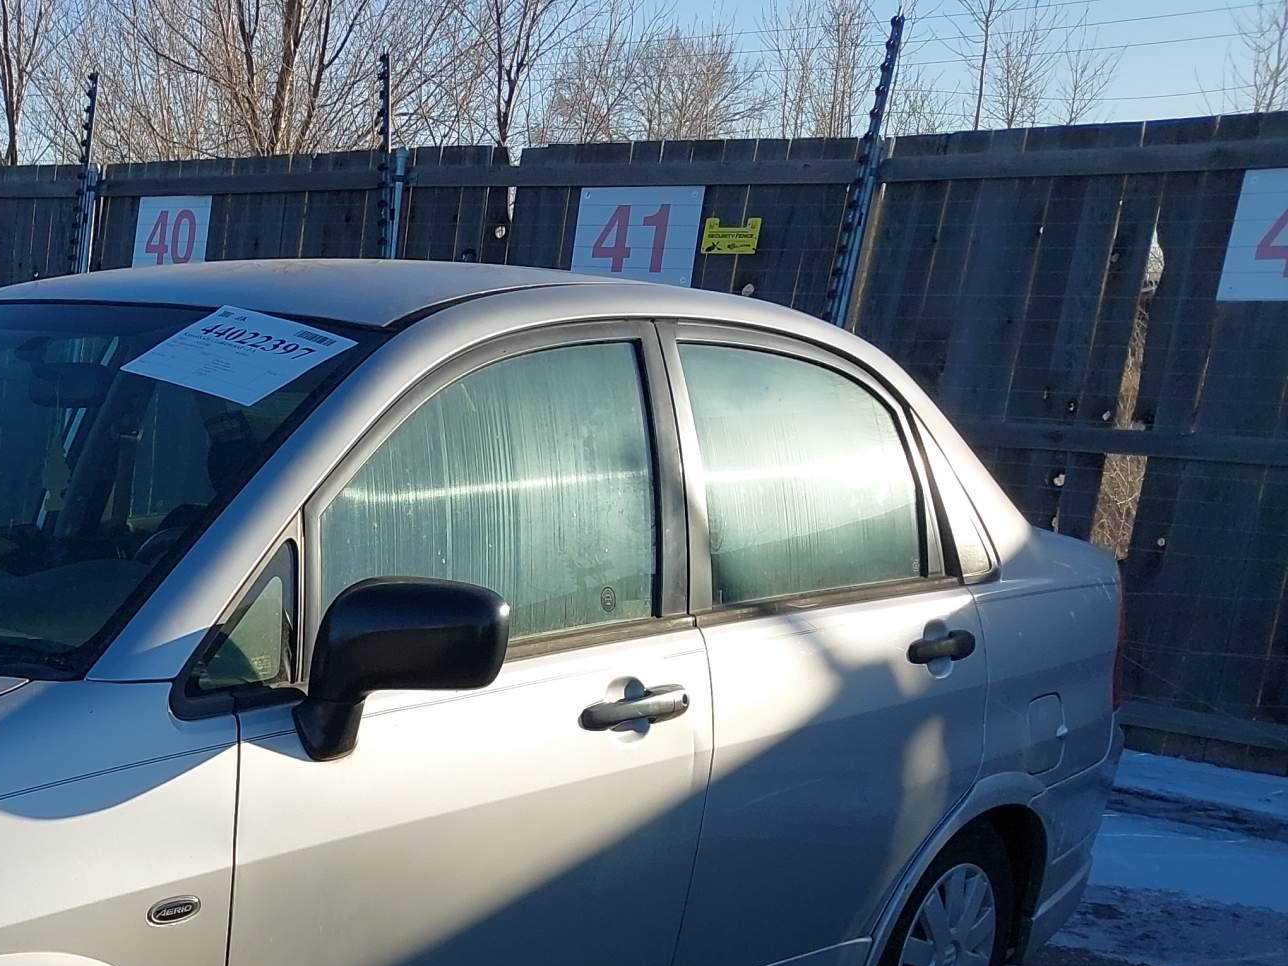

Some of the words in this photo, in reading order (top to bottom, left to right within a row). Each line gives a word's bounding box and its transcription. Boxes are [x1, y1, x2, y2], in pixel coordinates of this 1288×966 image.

[145, 209, 196, 265] 40
[592, 203, 671, 273] 41
[201, 323, 316, 360] 44022397
[155, 904, 193, 918] AERIO
